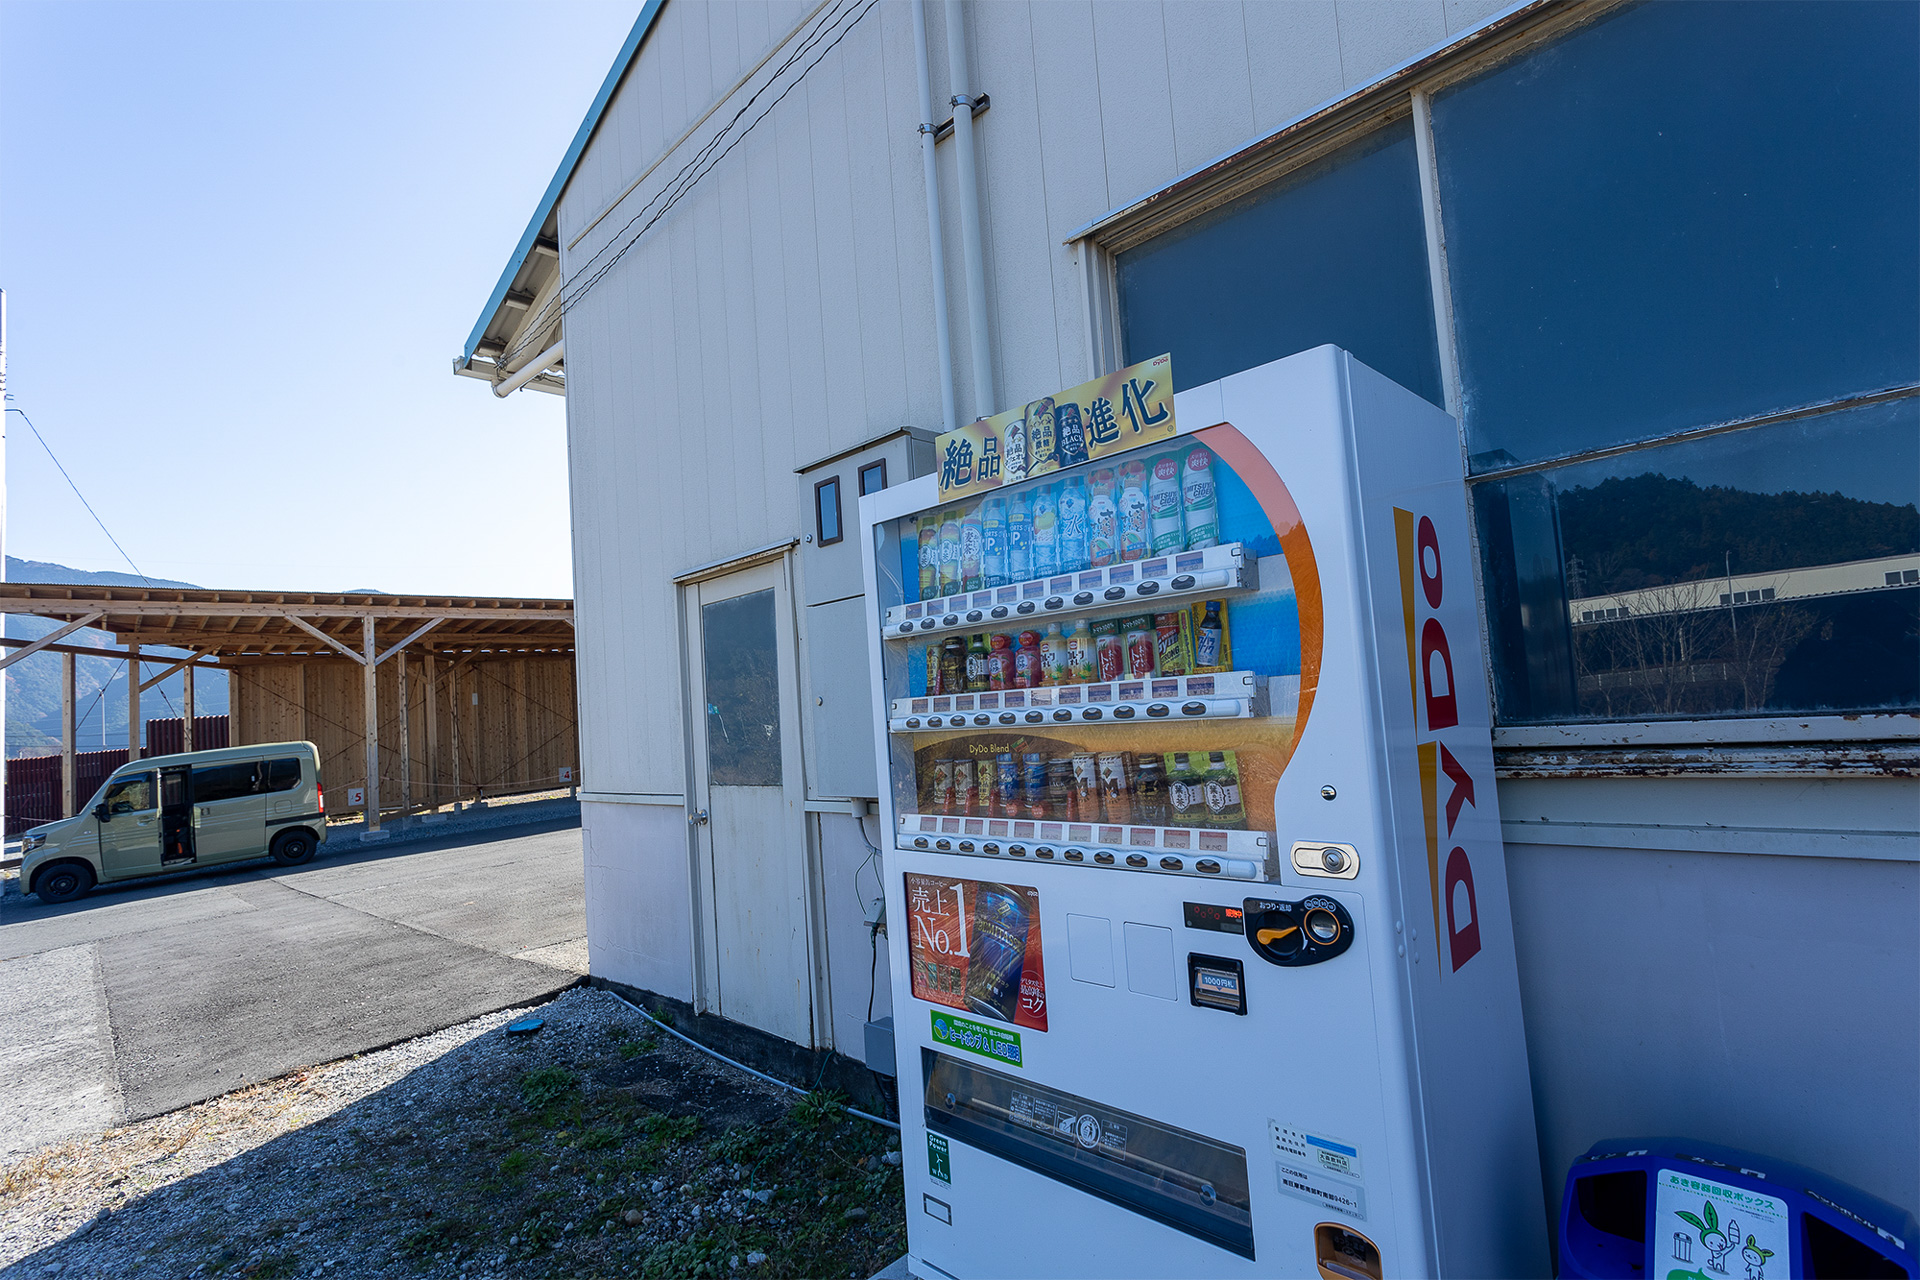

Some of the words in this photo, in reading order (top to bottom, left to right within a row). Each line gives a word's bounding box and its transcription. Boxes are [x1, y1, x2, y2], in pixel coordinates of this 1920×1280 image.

[940, 437, 1001, 490] 絶品
[1083, 377, 1169, 450] 進化
[1031, 425, 1052, 440] 絶品
[1190, 458, 1208, 468] 爽快
[1158, 467, 1175, 477] 爽快
[1064, 515, 1082, 537] 水
[969, 744, 988, 756] DyDo
[990, 743, 1010, 753] Blend
[355, 792, 362, 802] 5
[911, 886, 950, 917] 売上
[1204, 976, 1235, 988] 1000円札
[1022, 998, 1044, 1013] コク
[929, 1134, 947, 1147] Green
[1669, 1174, 1776, 1211] あき容器回収ボックス
